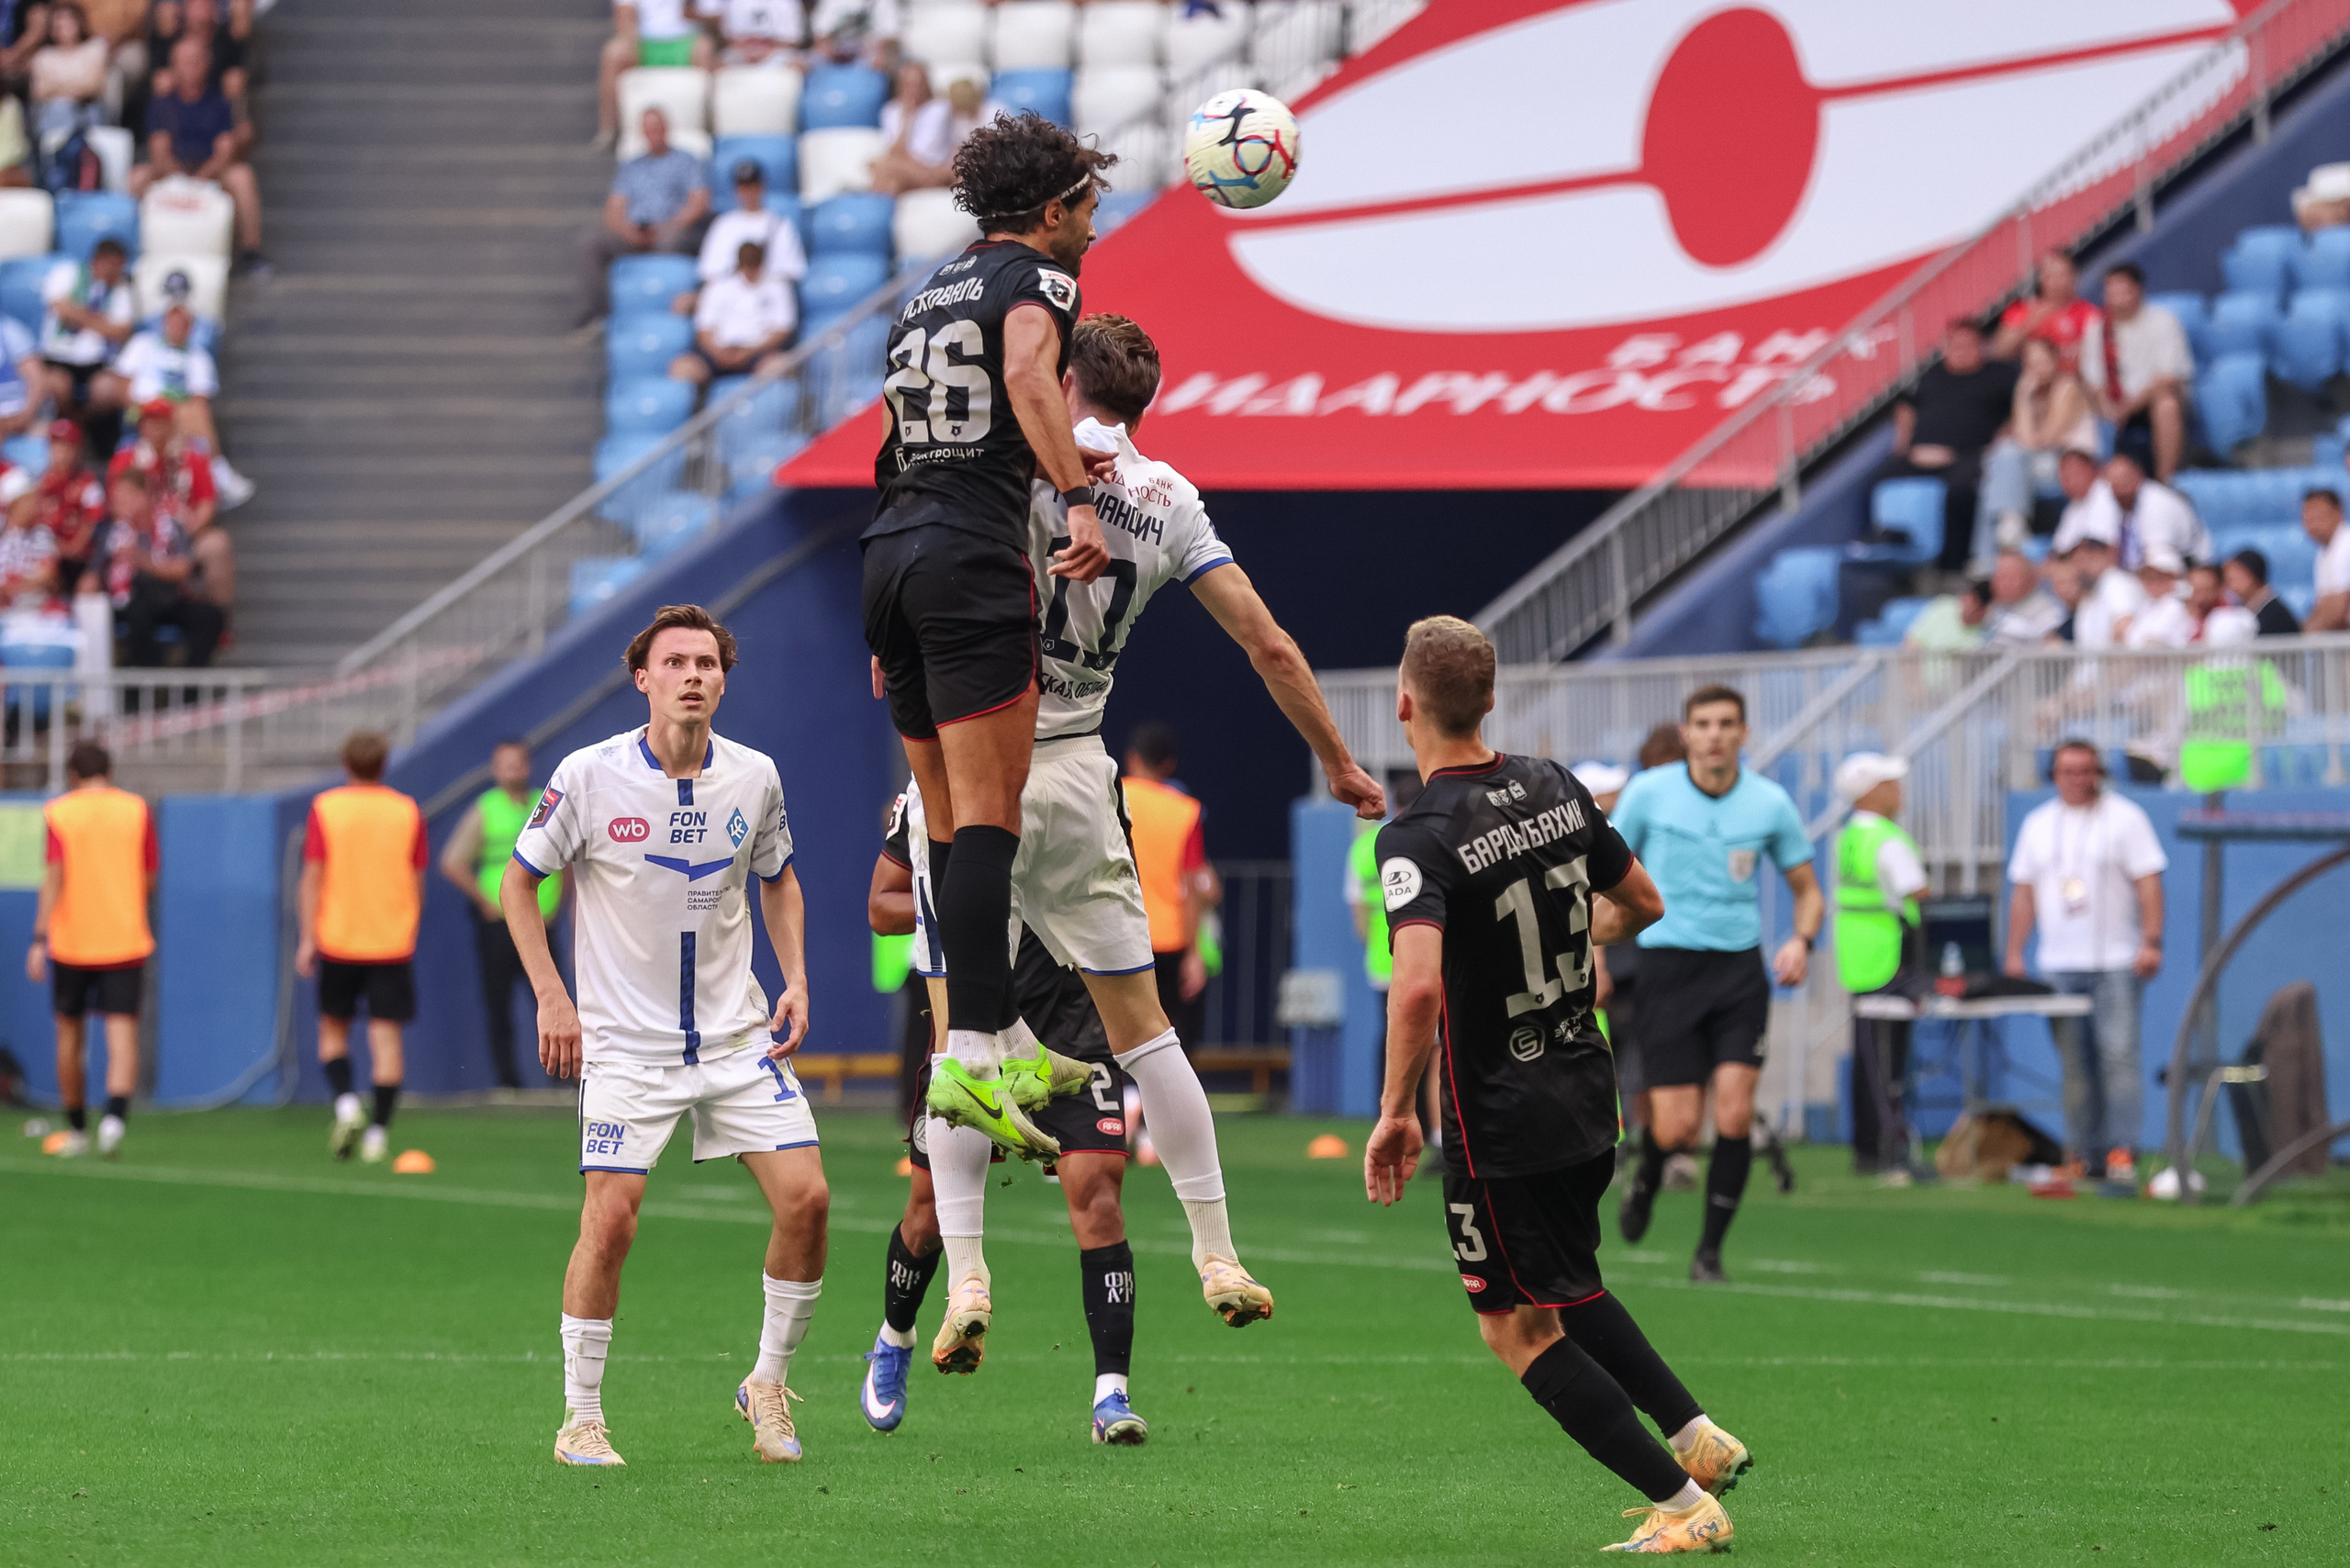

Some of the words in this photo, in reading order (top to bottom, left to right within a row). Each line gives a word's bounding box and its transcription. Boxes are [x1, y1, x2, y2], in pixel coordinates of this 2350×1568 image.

[884, 319, 991, 443] 26
[1148, 476, 1173, 491] БАНК
[669, 812, 707, 826] FON
[612, 819, 645, 838] wb
[670, 829, 708, 844] BET
[1458, 799, 1586, 875] БАРДЫБАХИН
[1494, 854, 1594, 1019] 13
[588, 1123, 625, 1139] FON
[586, 1140, 624, 1155] BET
[1453, 1203, 1487, 1261] 3
